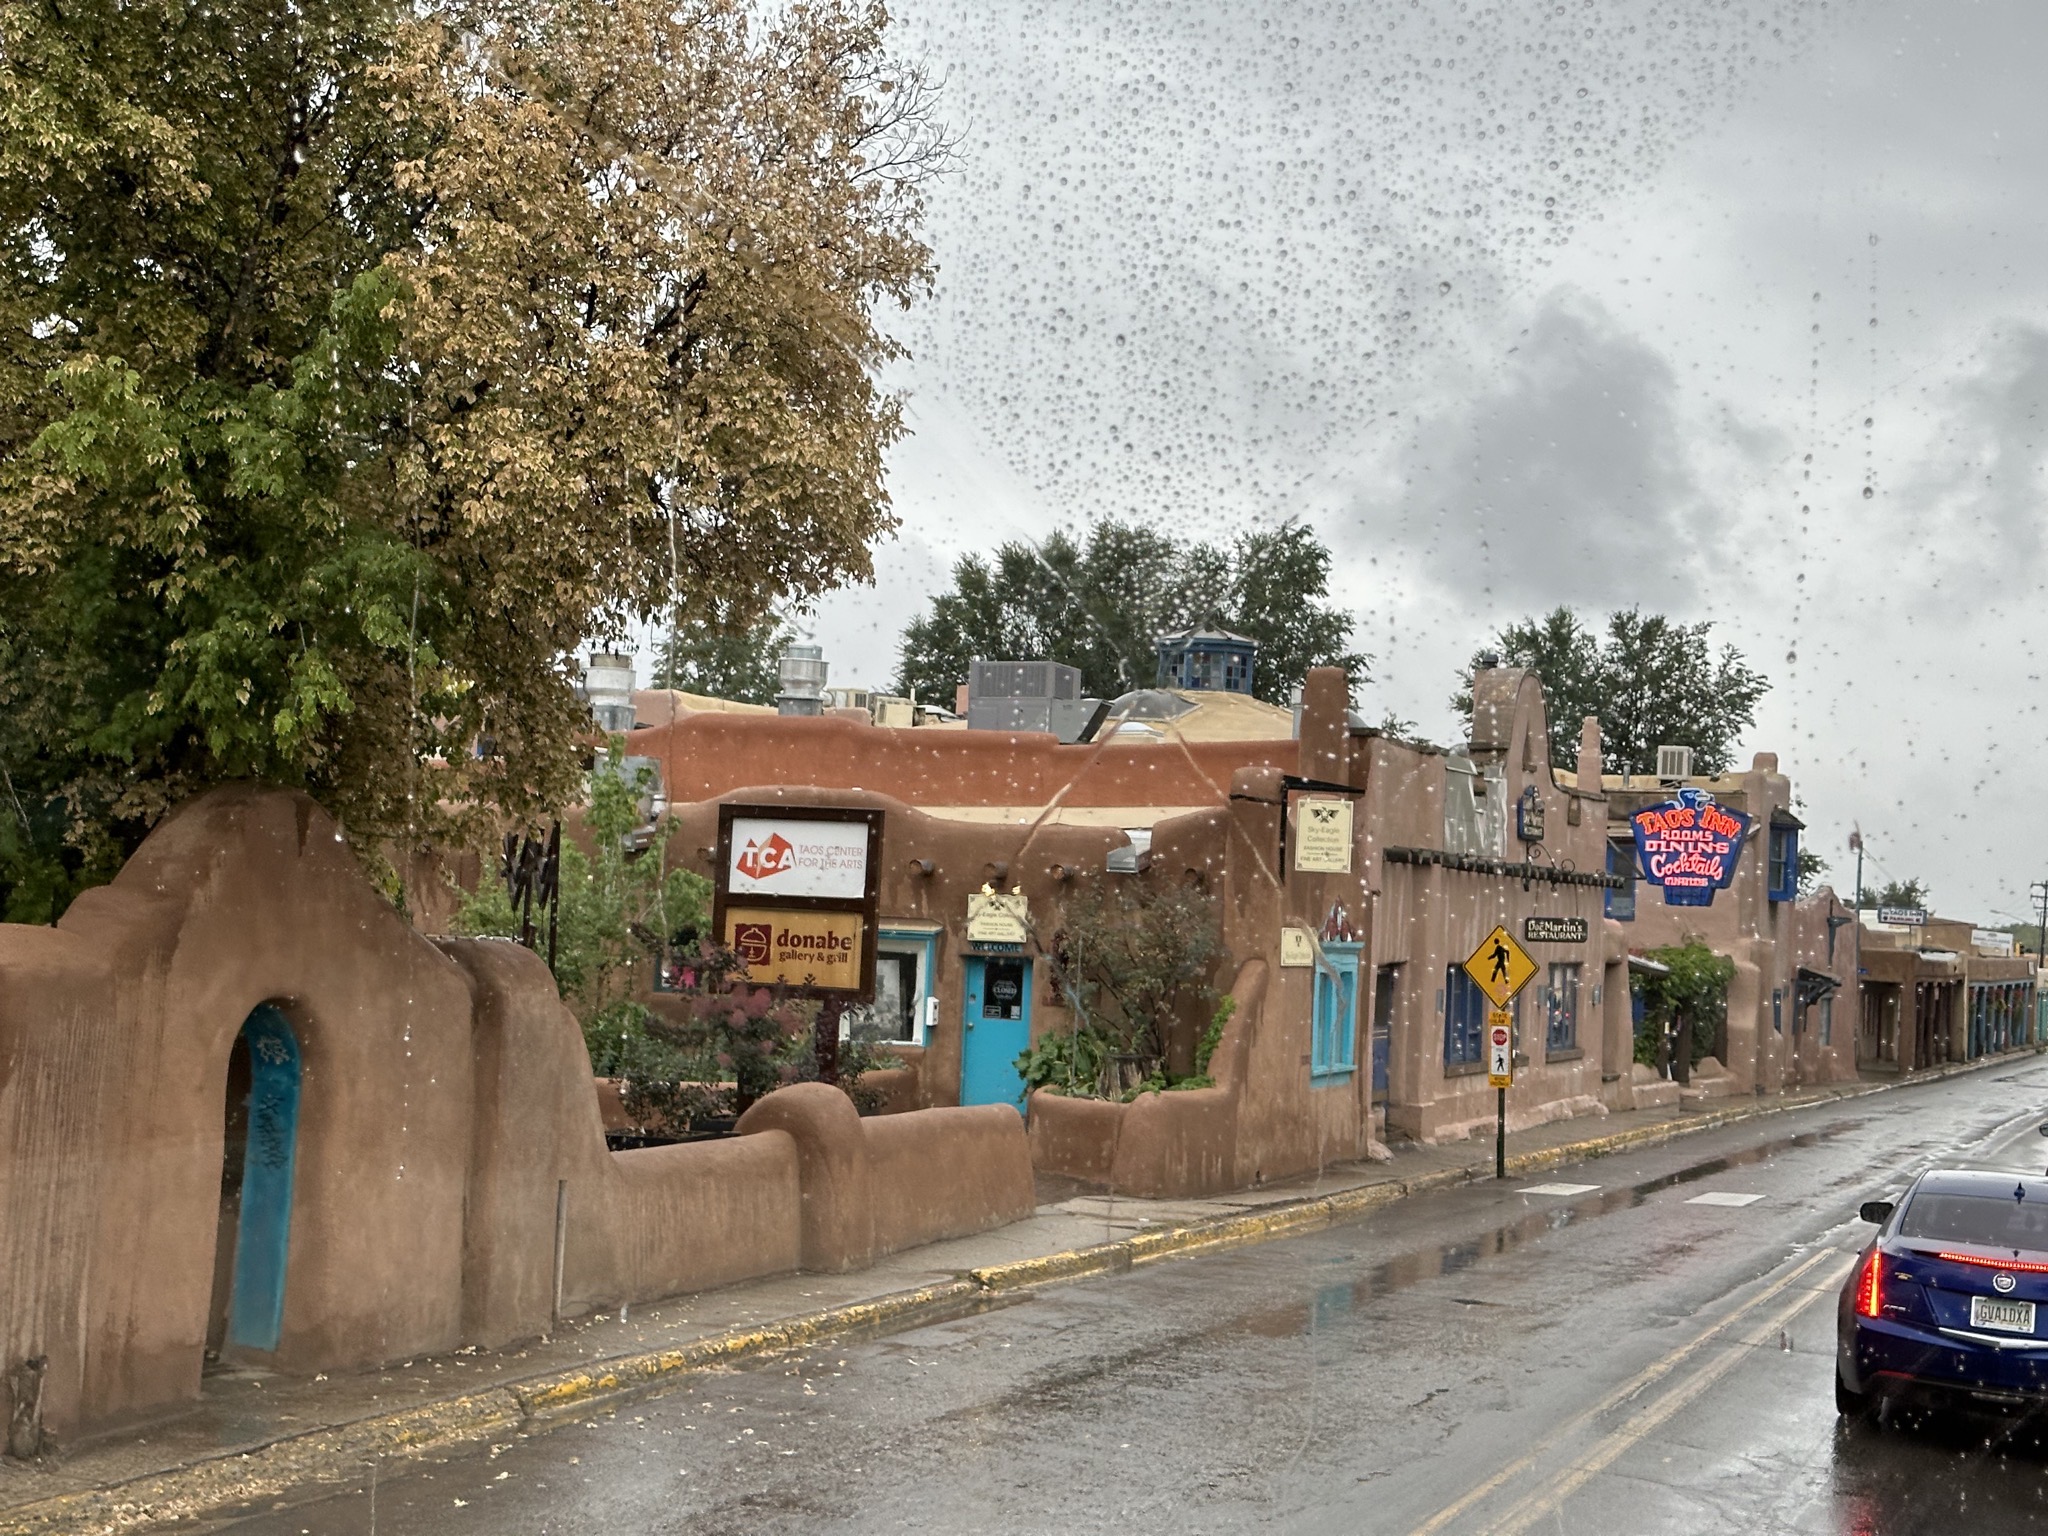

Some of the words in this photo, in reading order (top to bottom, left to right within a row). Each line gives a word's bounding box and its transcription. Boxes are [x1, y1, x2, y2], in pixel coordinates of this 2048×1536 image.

[1636, 808, 1696, 835] TAOS
[1698, 805, 1742, 838] INN
[1660, 829, 1714, 841] ROOMS
[799, 844, 824, 856] TAOS
[826, 846, 863, 858] CENTER
[1644, 840, 1730, 854] DINING
[799, 858, 818, 867] FOR
[820, 859, 838, 870] THE
[840, 859, 863, 870] ARTS
[1650, 852, 1723, 880] Cocktails
[1545, 921, 1583, 932] Martin's
[776, 928, 853, 951] donabe
[1528, 931, 1582, 940] RESTAURANT
[971, 943, 1023, 952] WELCOME
[779, 949, 815, 964] gallery
[816, 952, 825, 962] &
[826, 953, 848, 965] grill
